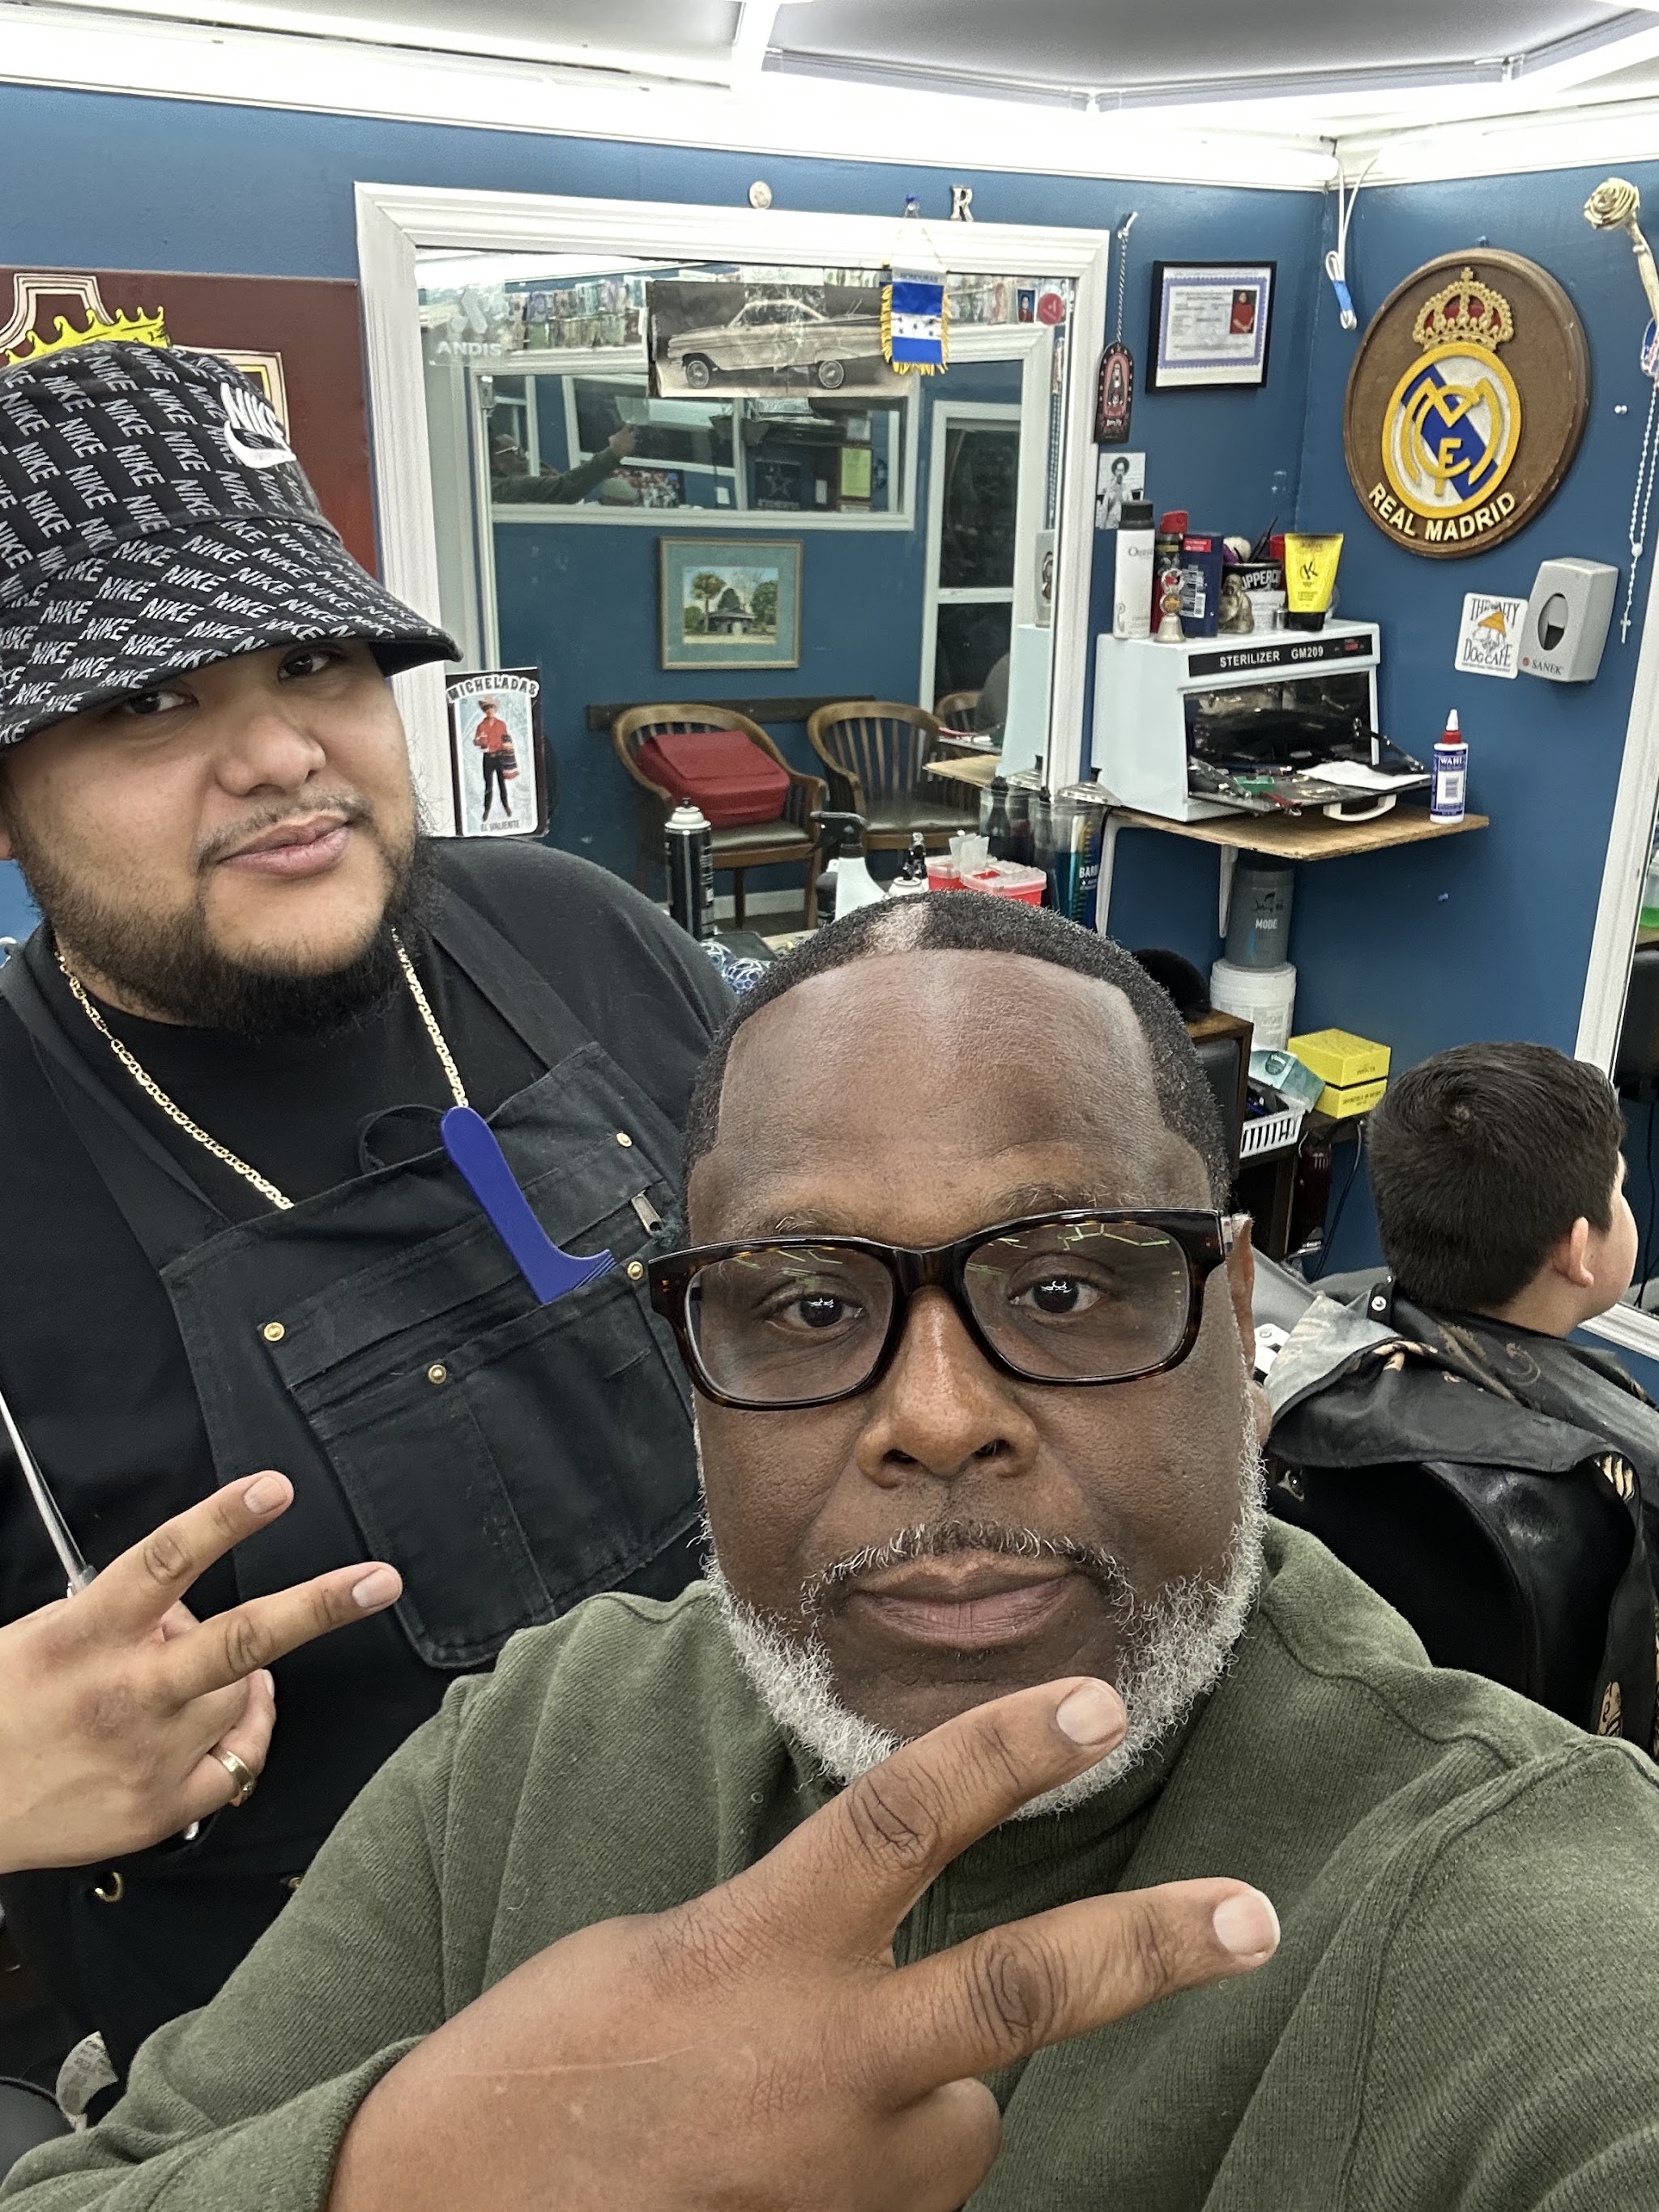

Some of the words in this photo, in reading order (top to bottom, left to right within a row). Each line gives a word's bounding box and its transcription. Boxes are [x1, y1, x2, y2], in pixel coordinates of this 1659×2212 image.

[950, 185, 974, 222] R
[437, 340, 502, 356] ANDIS
[84, 355, 139, 392] NIKE
[41, 375, 96, 413] NIKE
[143, 387, 198, 425] NIKE
[0, 391, 50, 437] NIKE
[100, 399, 155, 437] NIKE
[220, 381, 287, 441] NIKE
[55, 417, 108, 458] NIKE
[160, 430, 211, 472] NIKE
[12, 441, 61, 484] NIKE
[113, 444, 165, 487] NIKE
[65, 465, 117, 509] NIKE
[171, 479, 221, 517] NIKE
[215, 470, 263, 512] NIKE
[21, 490, 72, 539] NIKE
[1369, 483, 1415, 536] REAL
[1425, 492, 1516, 542] MADRID
[112, 539, 178, 567] NIKE
[181, 535, 249, 565] NIKE
[251, 548, 314, 578] NIKE
[95, 576, 157, 602] NIKE
[160, 565, 229, 593] NIKE
[229, 566, 294, 595] NIKE
[316, 570, 371, 602] NIKE
[40, 599, 94, 624] NIKE
[139, 597, 205, 624] NIKE
[208, 591, 277, 619] NIKE
[279, 599, 345, 624] NIKE
[298, 582, 357, 612] NIKE
[79, 617, 138, 641] NIKE
[185, 620, 253, 640] NIKE
[258, 619, 326, 641] NIKE
[27, 641, 79, 665] NIKE
[120, 634, 183, 657] NIKE
[1220, 650, 1280, 668] STERILIZER
[1290, 646, 1324, 660] GM209
[61, 657, 116, 680] NIKE
[97, 667, 157, 689] NIKE
[9, 682, 59, 705] NIKE
[448, 676, 538, 700] MICHELADAS
[1256, 918, 1277, 929] MODE
